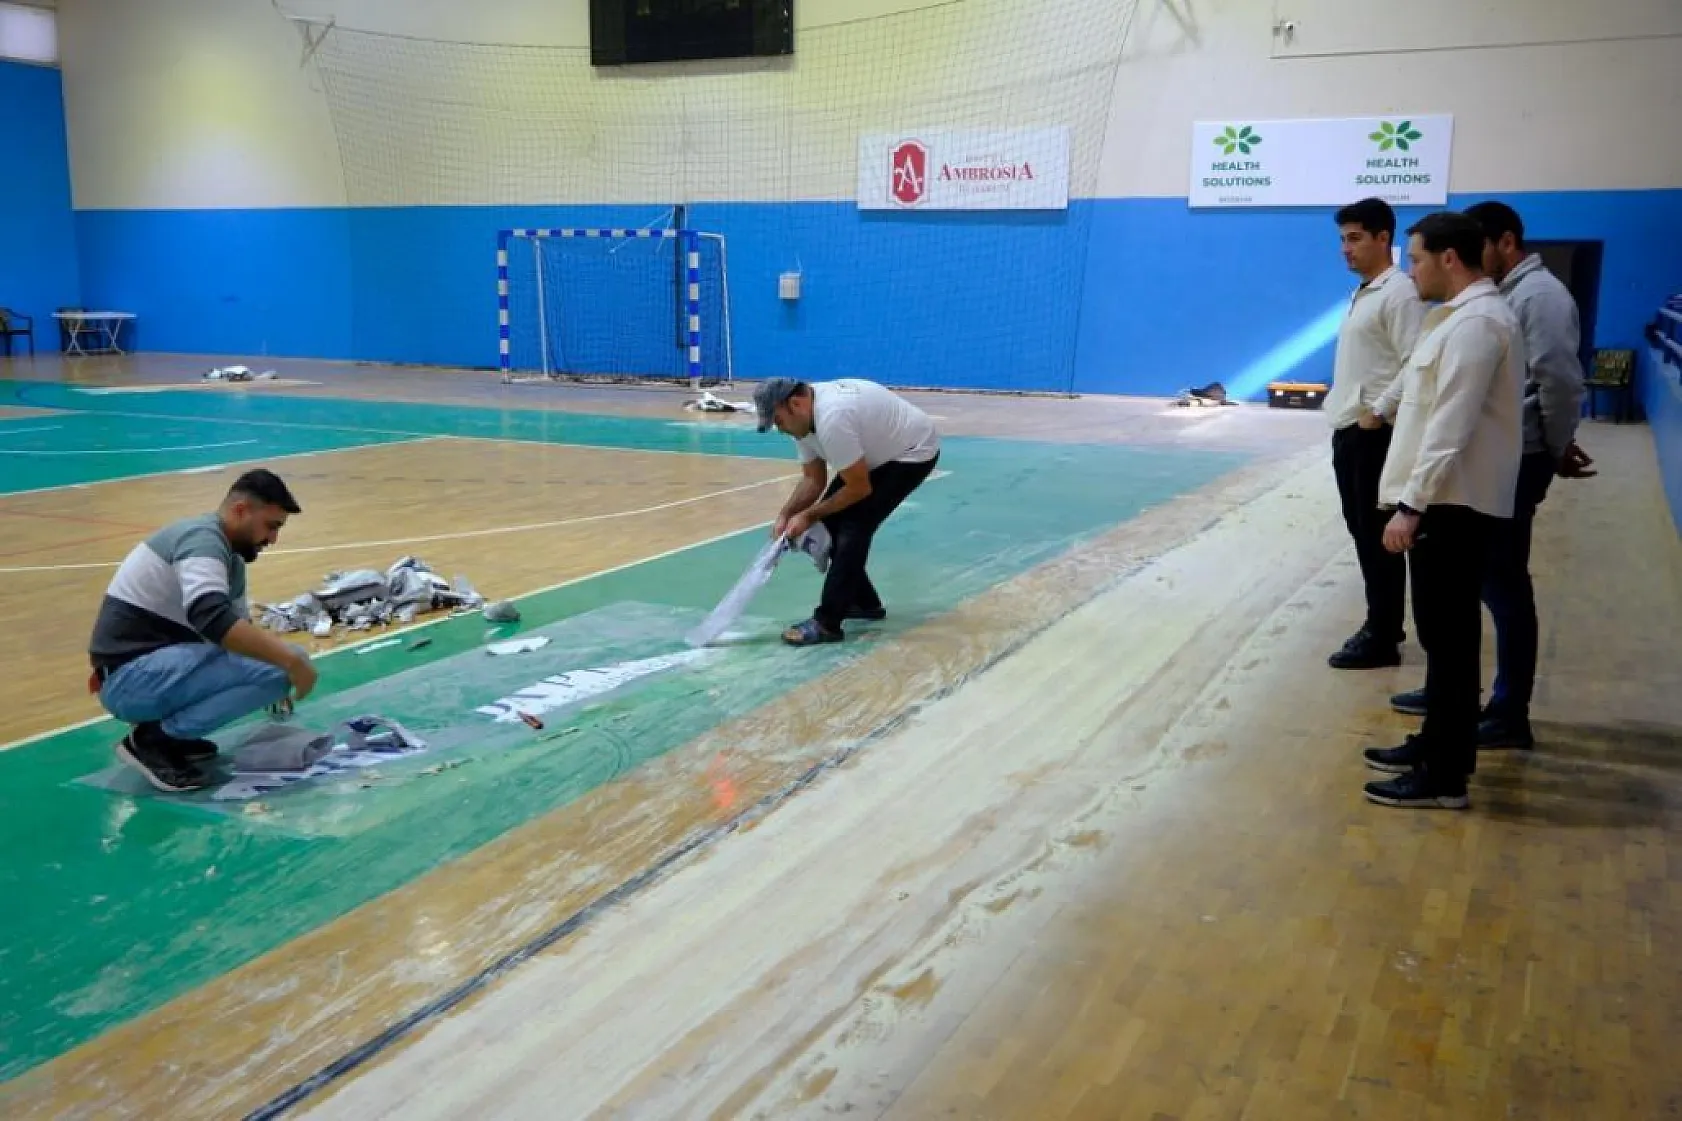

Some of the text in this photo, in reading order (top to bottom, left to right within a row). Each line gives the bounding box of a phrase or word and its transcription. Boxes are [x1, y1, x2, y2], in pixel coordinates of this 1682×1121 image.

[1211, 161, 1261, 171] HEALTH
[1365, 158, 1419, 168] HEALTH
[1202, 177, 1271, 187] SOLUTIONS
[1354, 174, 1431, 184] SOLUTIONS
